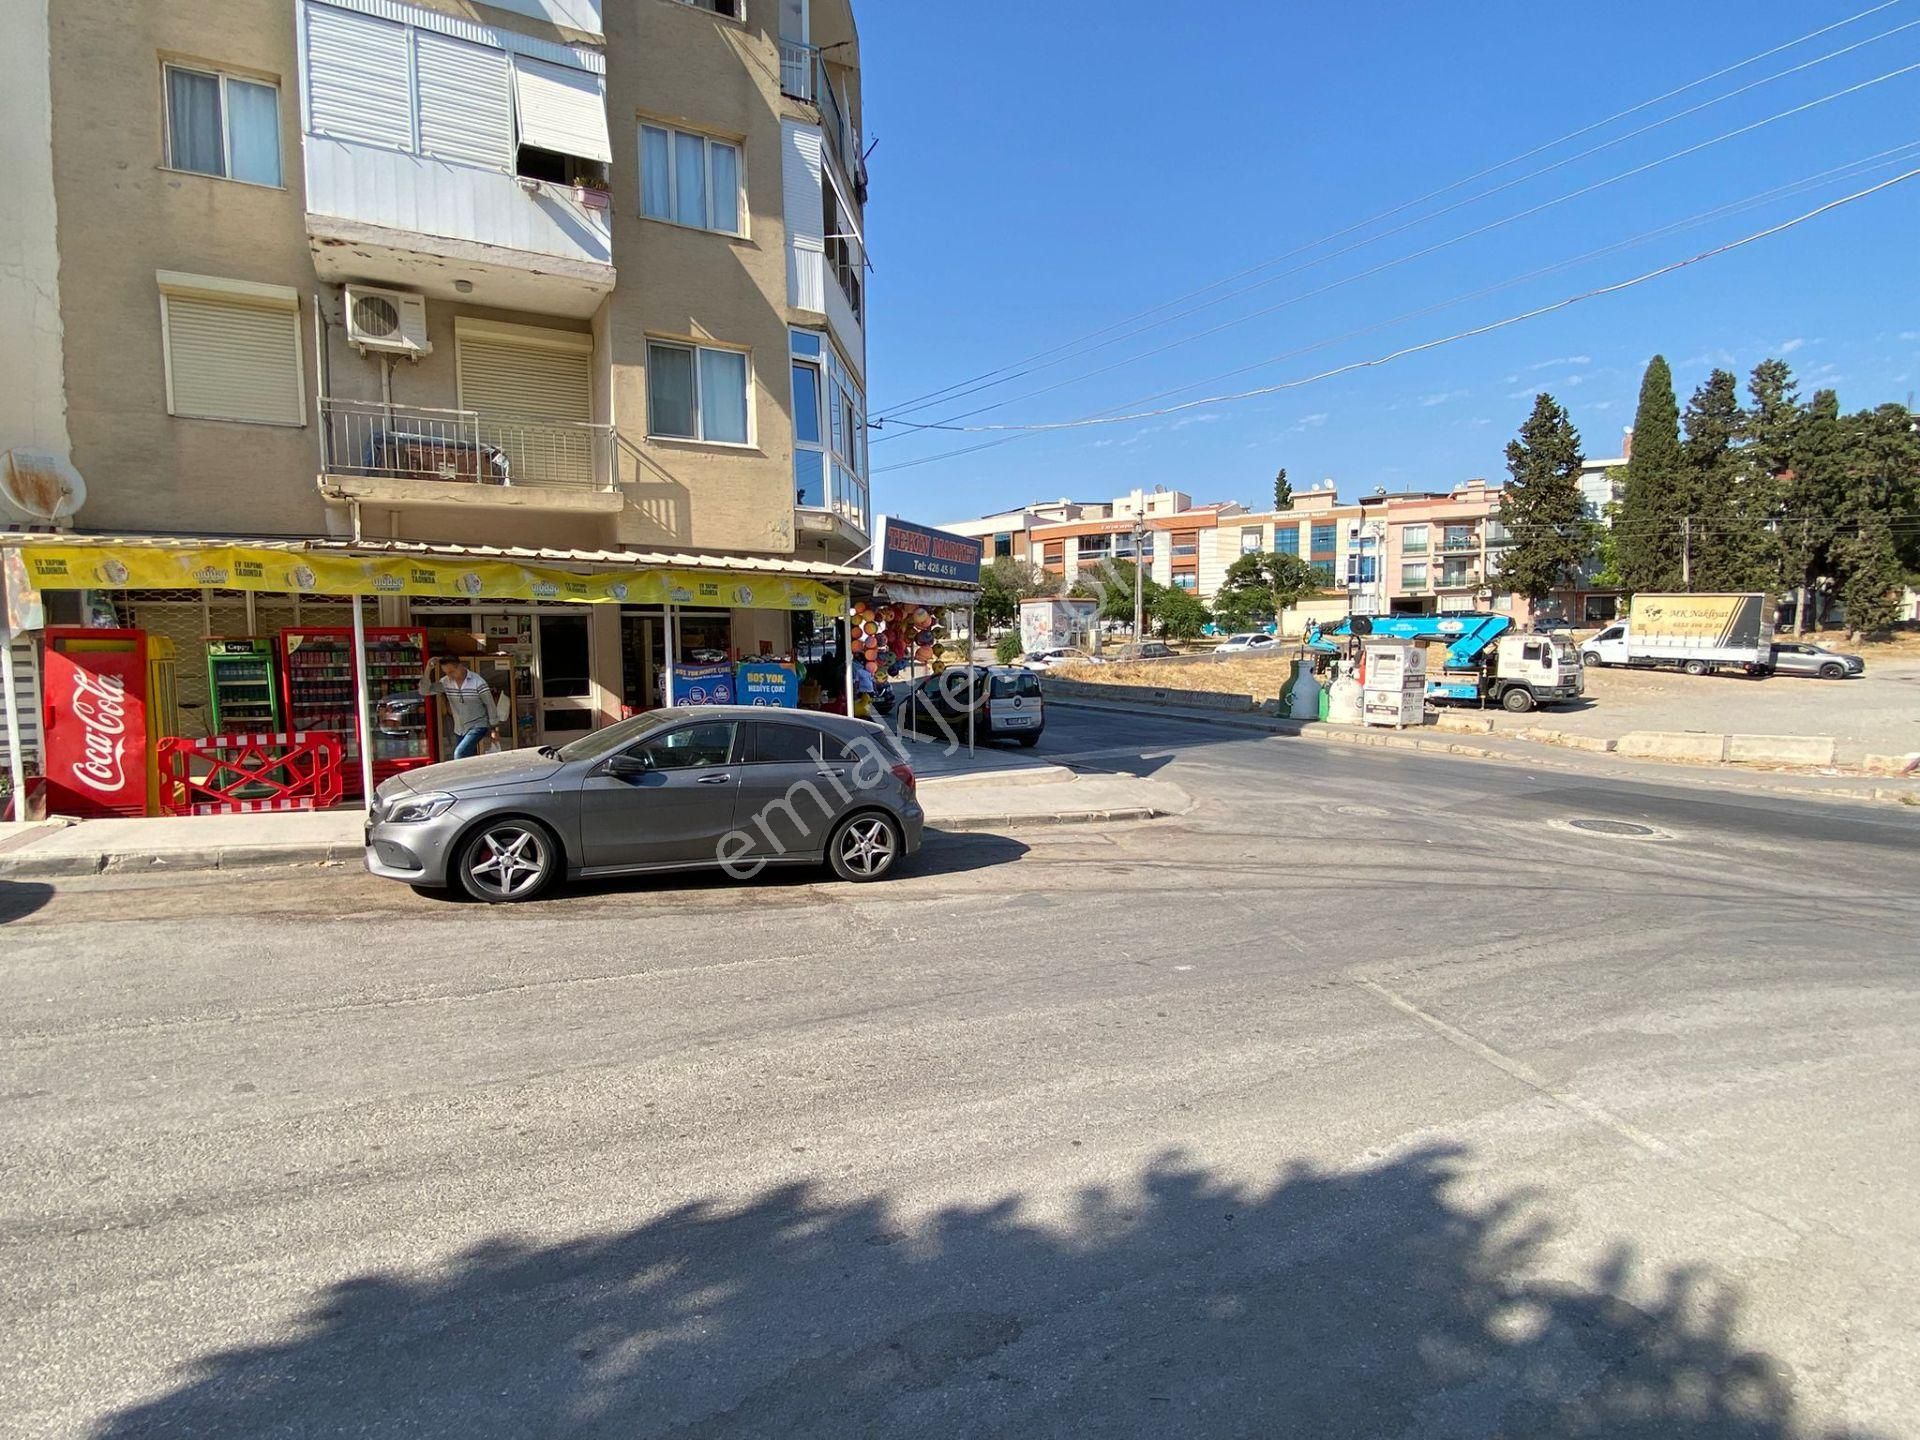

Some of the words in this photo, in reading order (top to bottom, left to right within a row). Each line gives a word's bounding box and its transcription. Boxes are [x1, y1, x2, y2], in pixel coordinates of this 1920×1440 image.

[932, 537, 977, 565] MARKET
[913, 560, 927, 571] Tel:
[940, 564, 949, 575] 45
